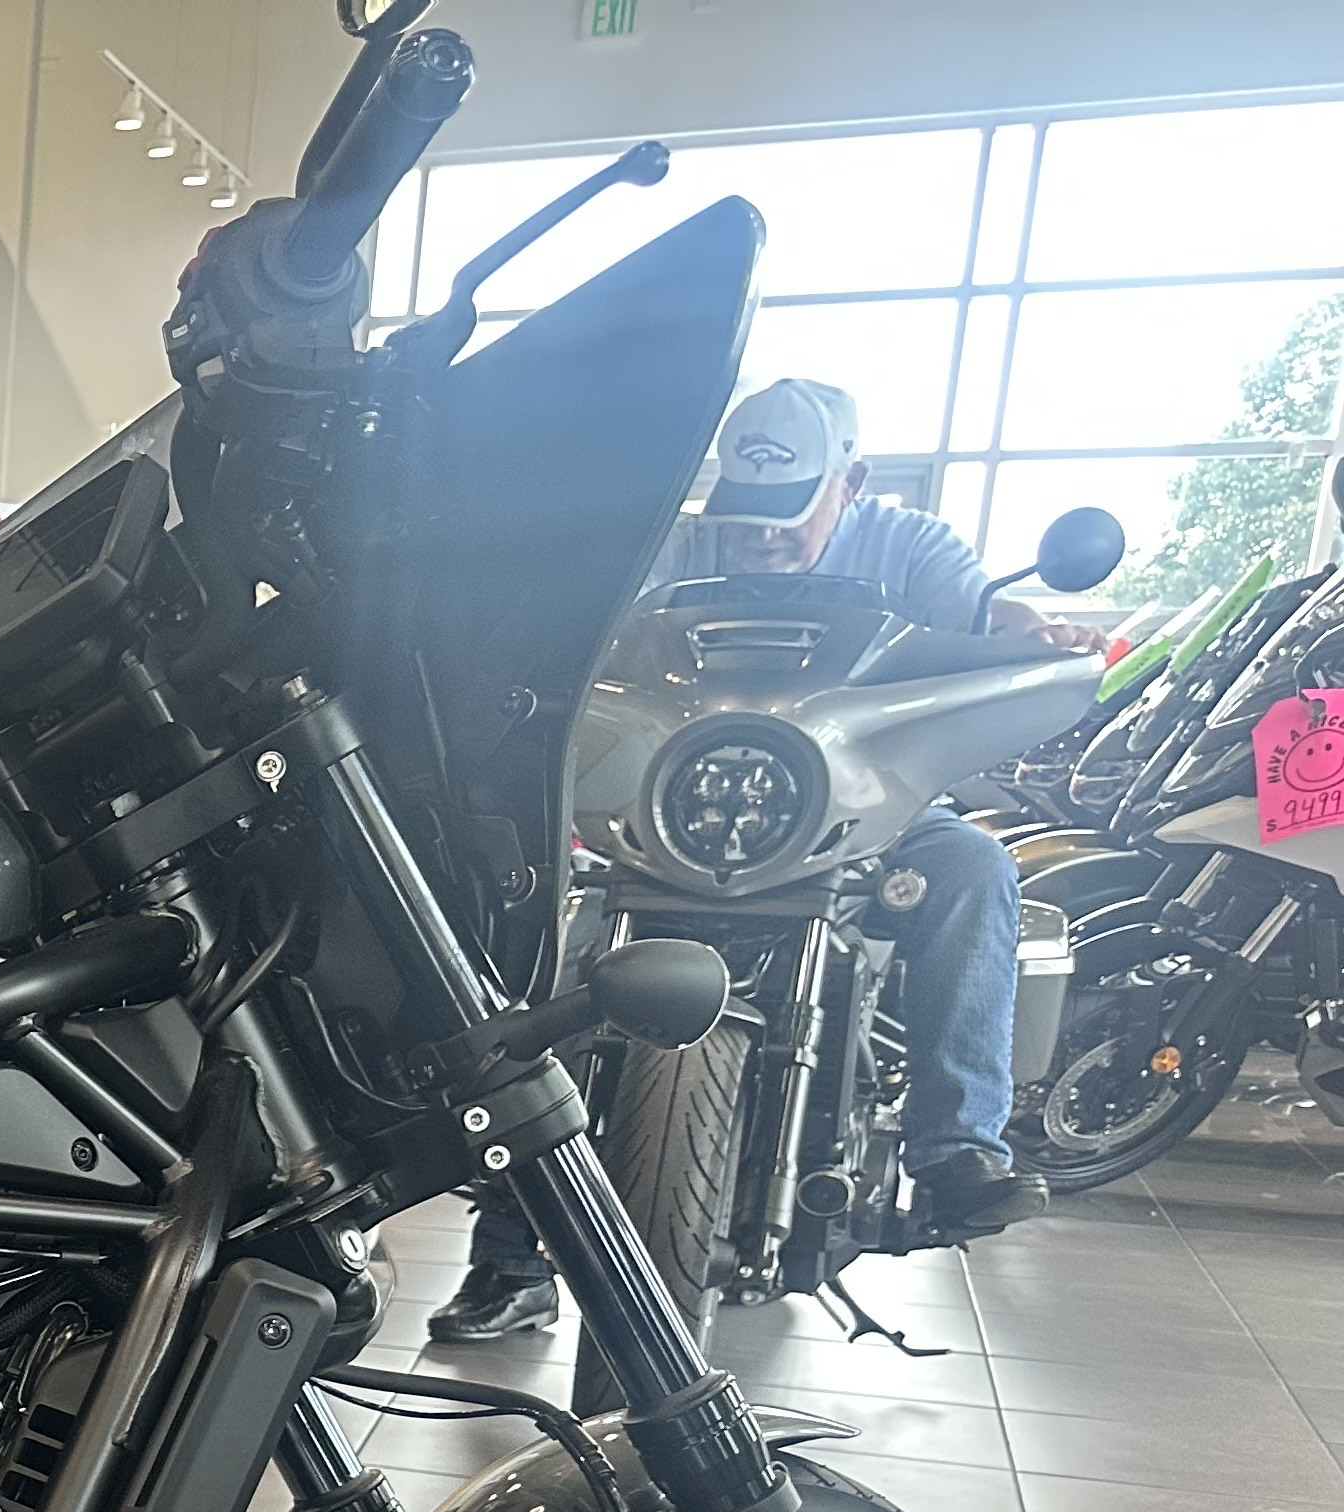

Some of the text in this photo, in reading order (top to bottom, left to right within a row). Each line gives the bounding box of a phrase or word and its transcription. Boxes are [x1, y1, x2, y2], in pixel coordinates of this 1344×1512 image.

[591, 0, 640, 37] EXIT
[1266, 745, 1288, 784] HAVE
[1290, 729, 1301, 741] A
[1283, 789, 1342, 827] 9499
